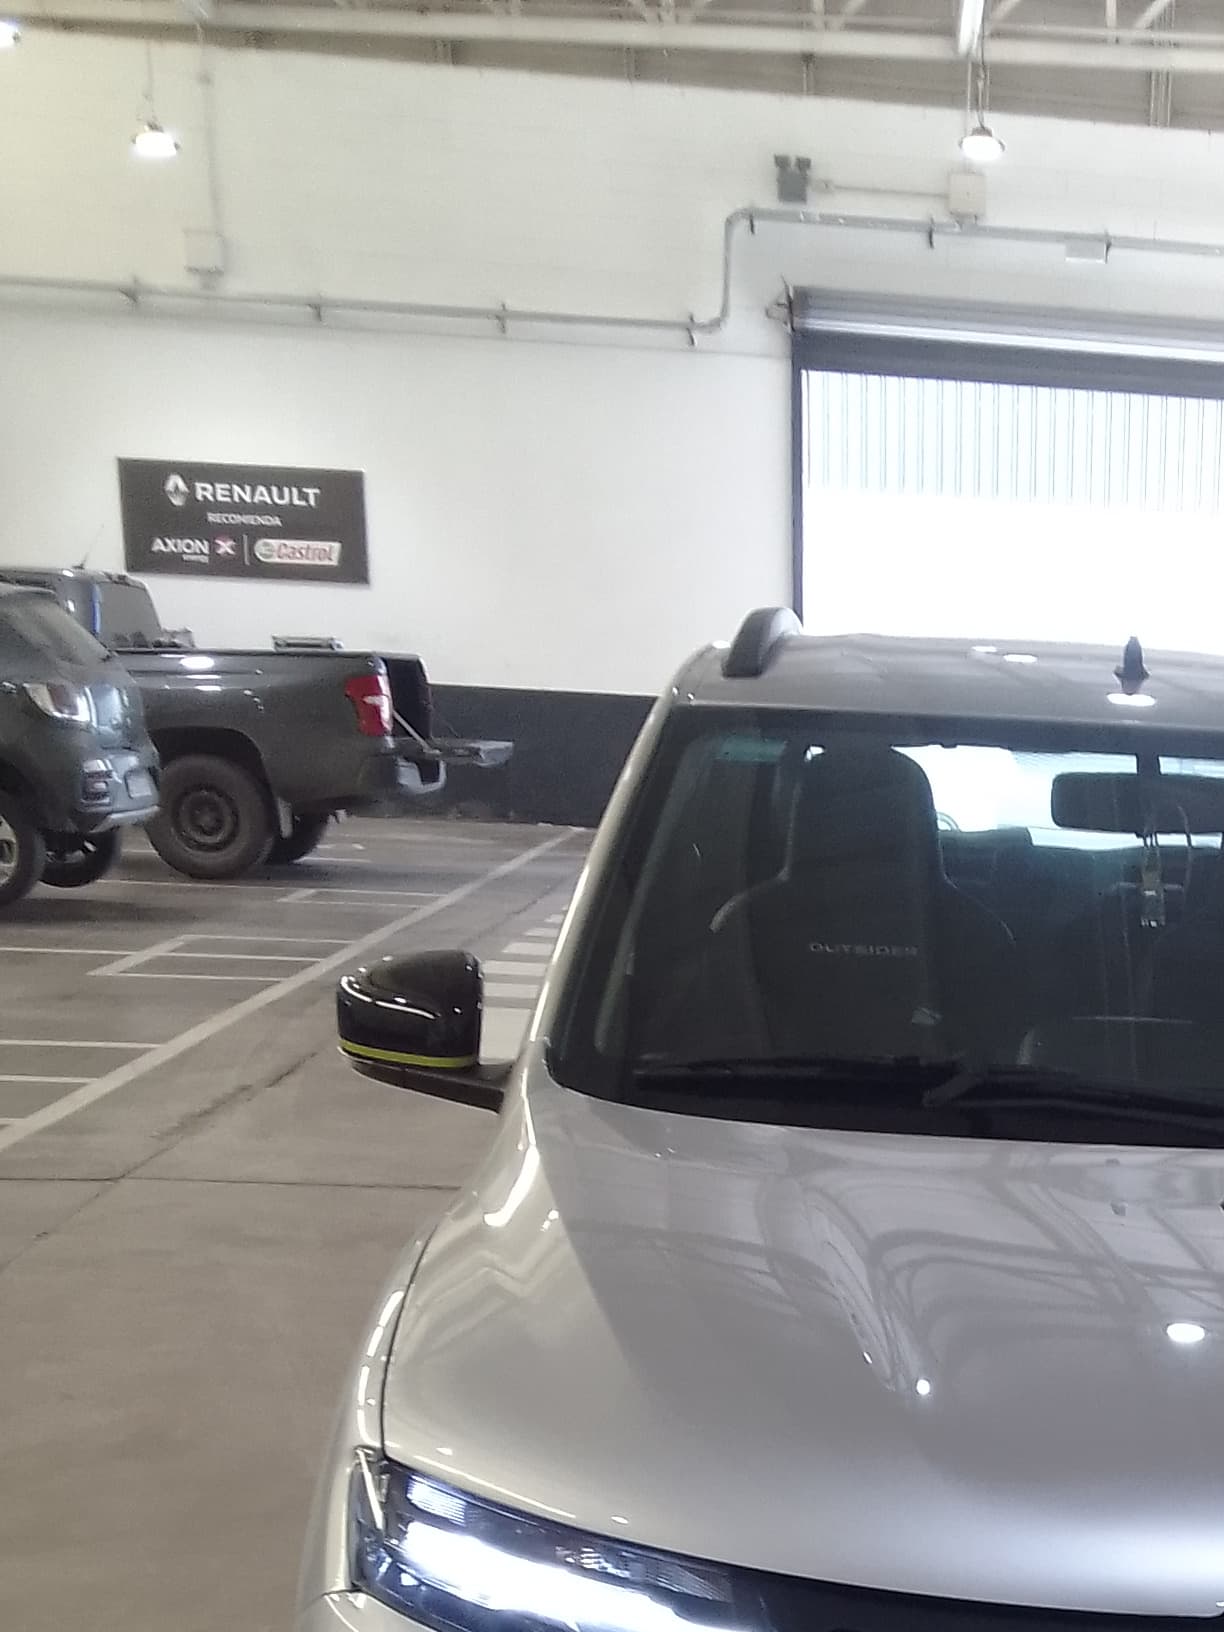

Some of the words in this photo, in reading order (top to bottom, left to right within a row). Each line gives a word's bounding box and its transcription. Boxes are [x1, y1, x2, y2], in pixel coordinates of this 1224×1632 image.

[194, 481, 321, 508] RENAULT
[206, 511, 283, 528] RECOMIENDA
[151, 536, 209, 554] AXION
[276, 542, 334, 562] Castrol
